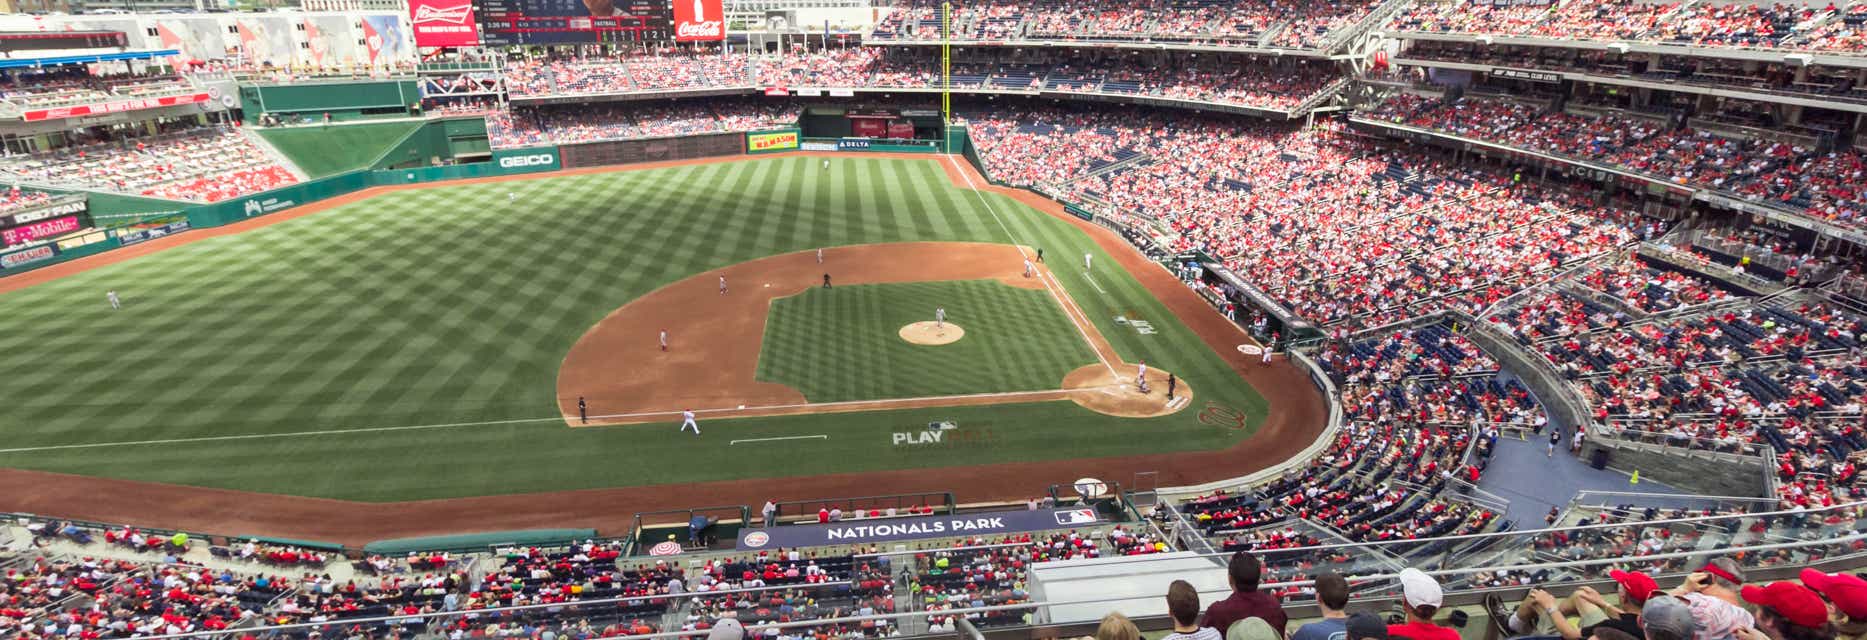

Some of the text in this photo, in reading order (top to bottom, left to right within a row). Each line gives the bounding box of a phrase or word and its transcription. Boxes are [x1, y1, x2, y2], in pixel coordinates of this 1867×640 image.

[652, 31, 658, 39] 2
[678, 21, 721, 36] Coca-Cola
[500, 154, 553, 168] GEICO
[52, 201, 87, 216] FAN
[893, 430, 943, 445] PLAY
[828, 517, 1005, 540] NATIONALS PARK
